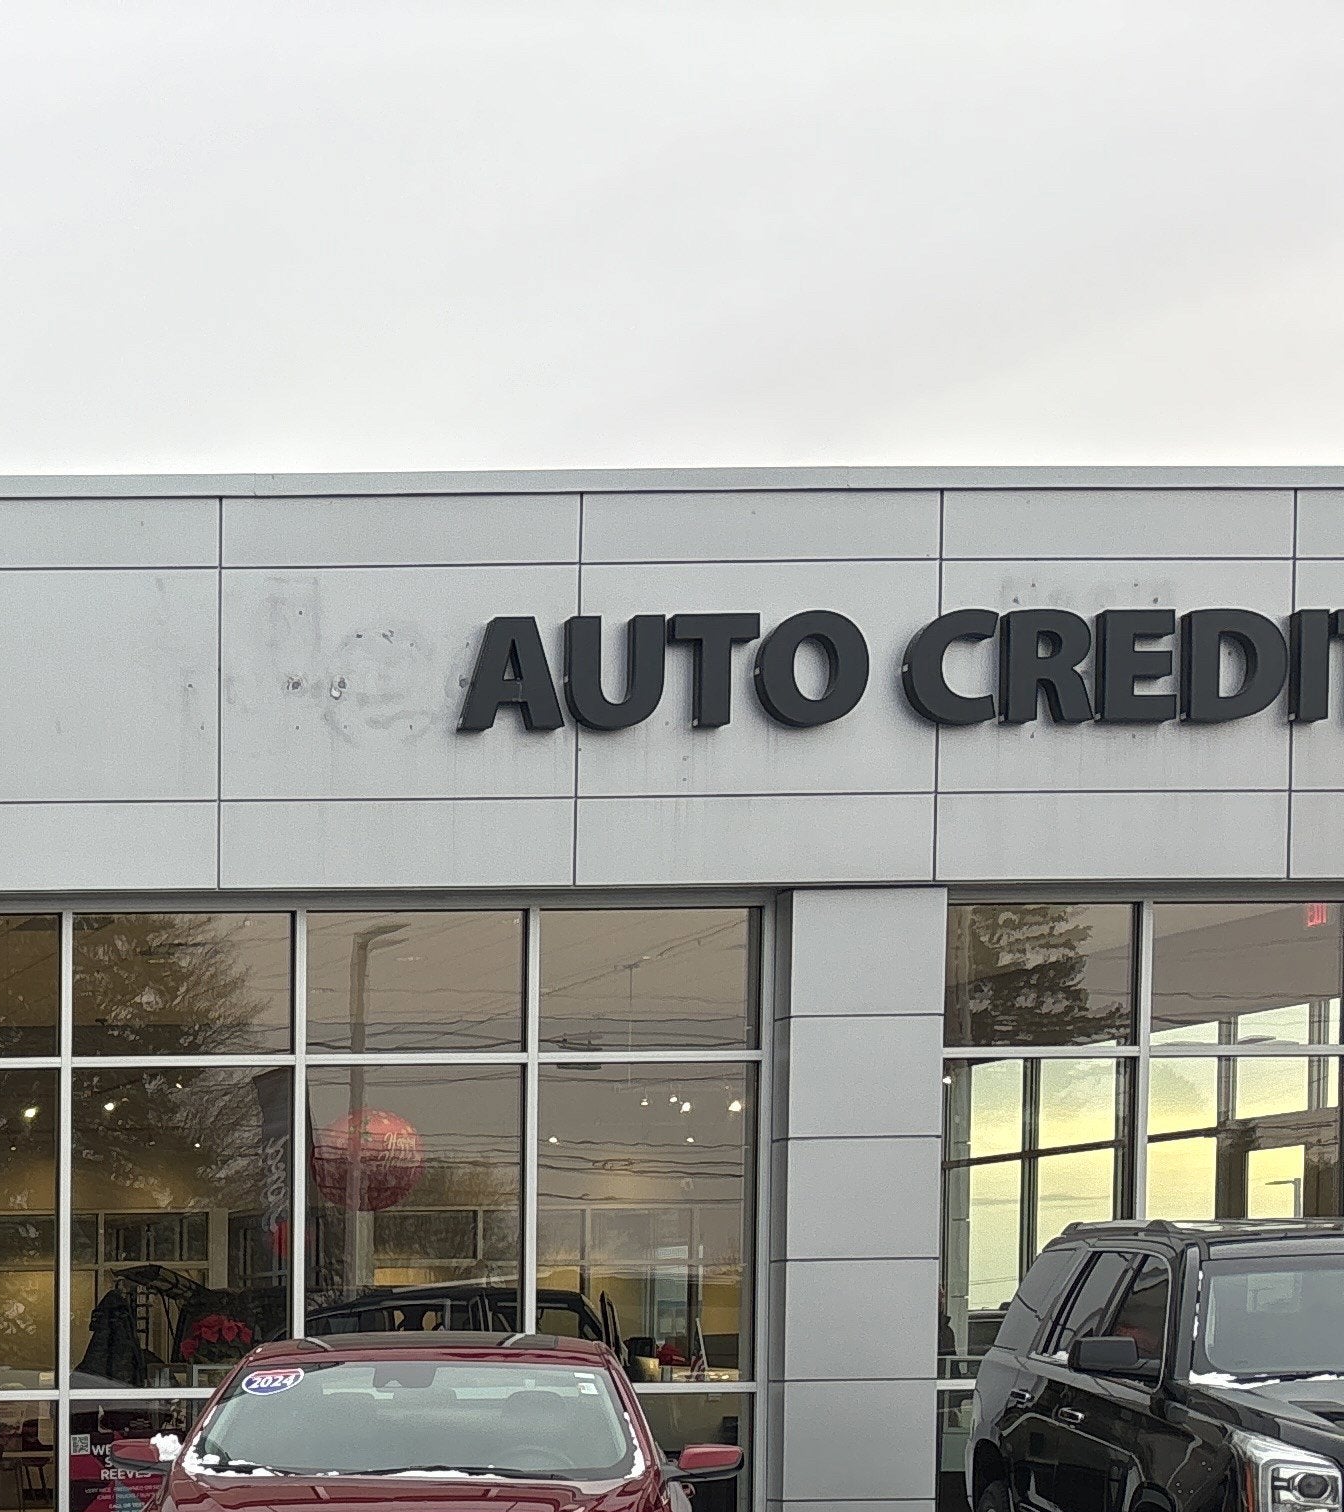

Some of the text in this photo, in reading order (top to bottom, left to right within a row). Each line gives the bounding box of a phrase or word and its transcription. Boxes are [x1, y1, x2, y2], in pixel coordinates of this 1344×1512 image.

[456, 607, 1344, 732] AUTO CREDI
[247, 1373, 296, 1389] 2024
